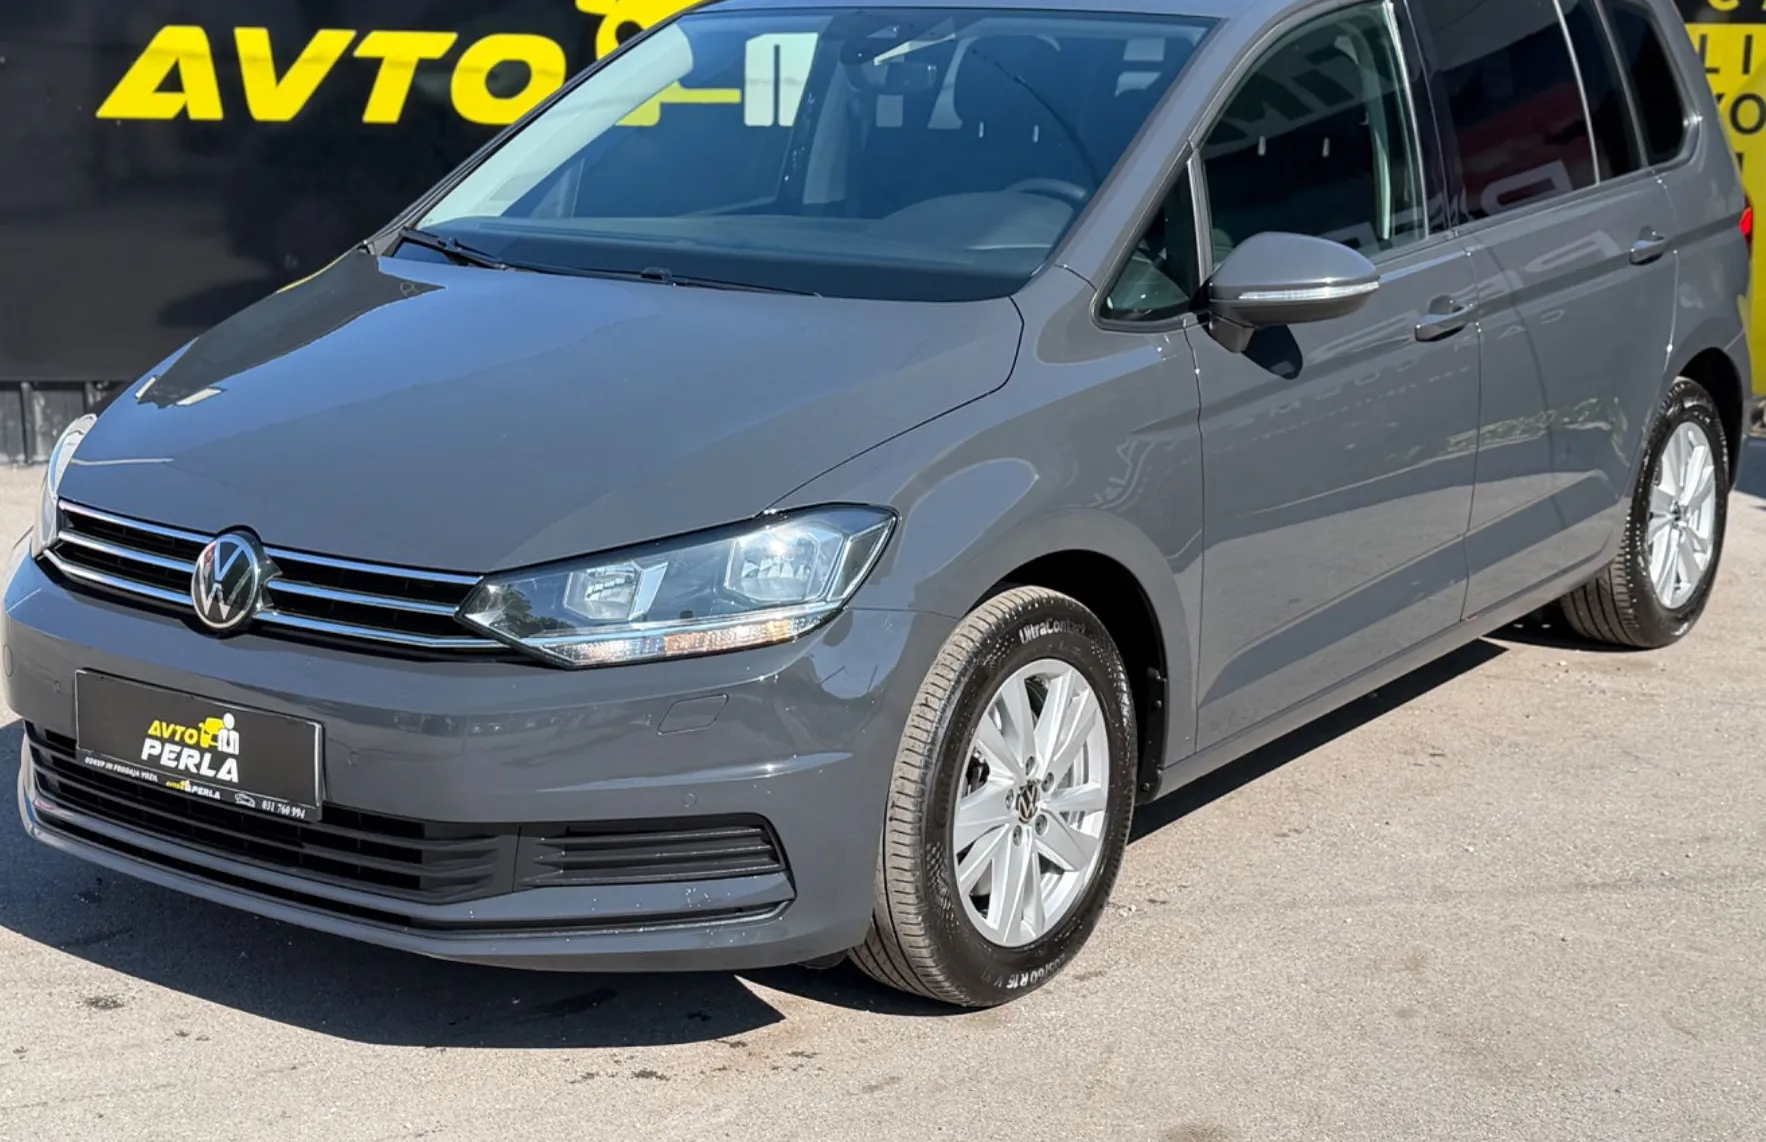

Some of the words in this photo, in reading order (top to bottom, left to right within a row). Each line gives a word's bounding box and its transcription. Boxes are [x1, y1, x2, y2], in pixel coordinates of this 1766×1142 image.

[96, 25, 566, 125] AVTO
[147, 719, 199, 745] AVTO
[140, 737, 239, 783] PERLA
